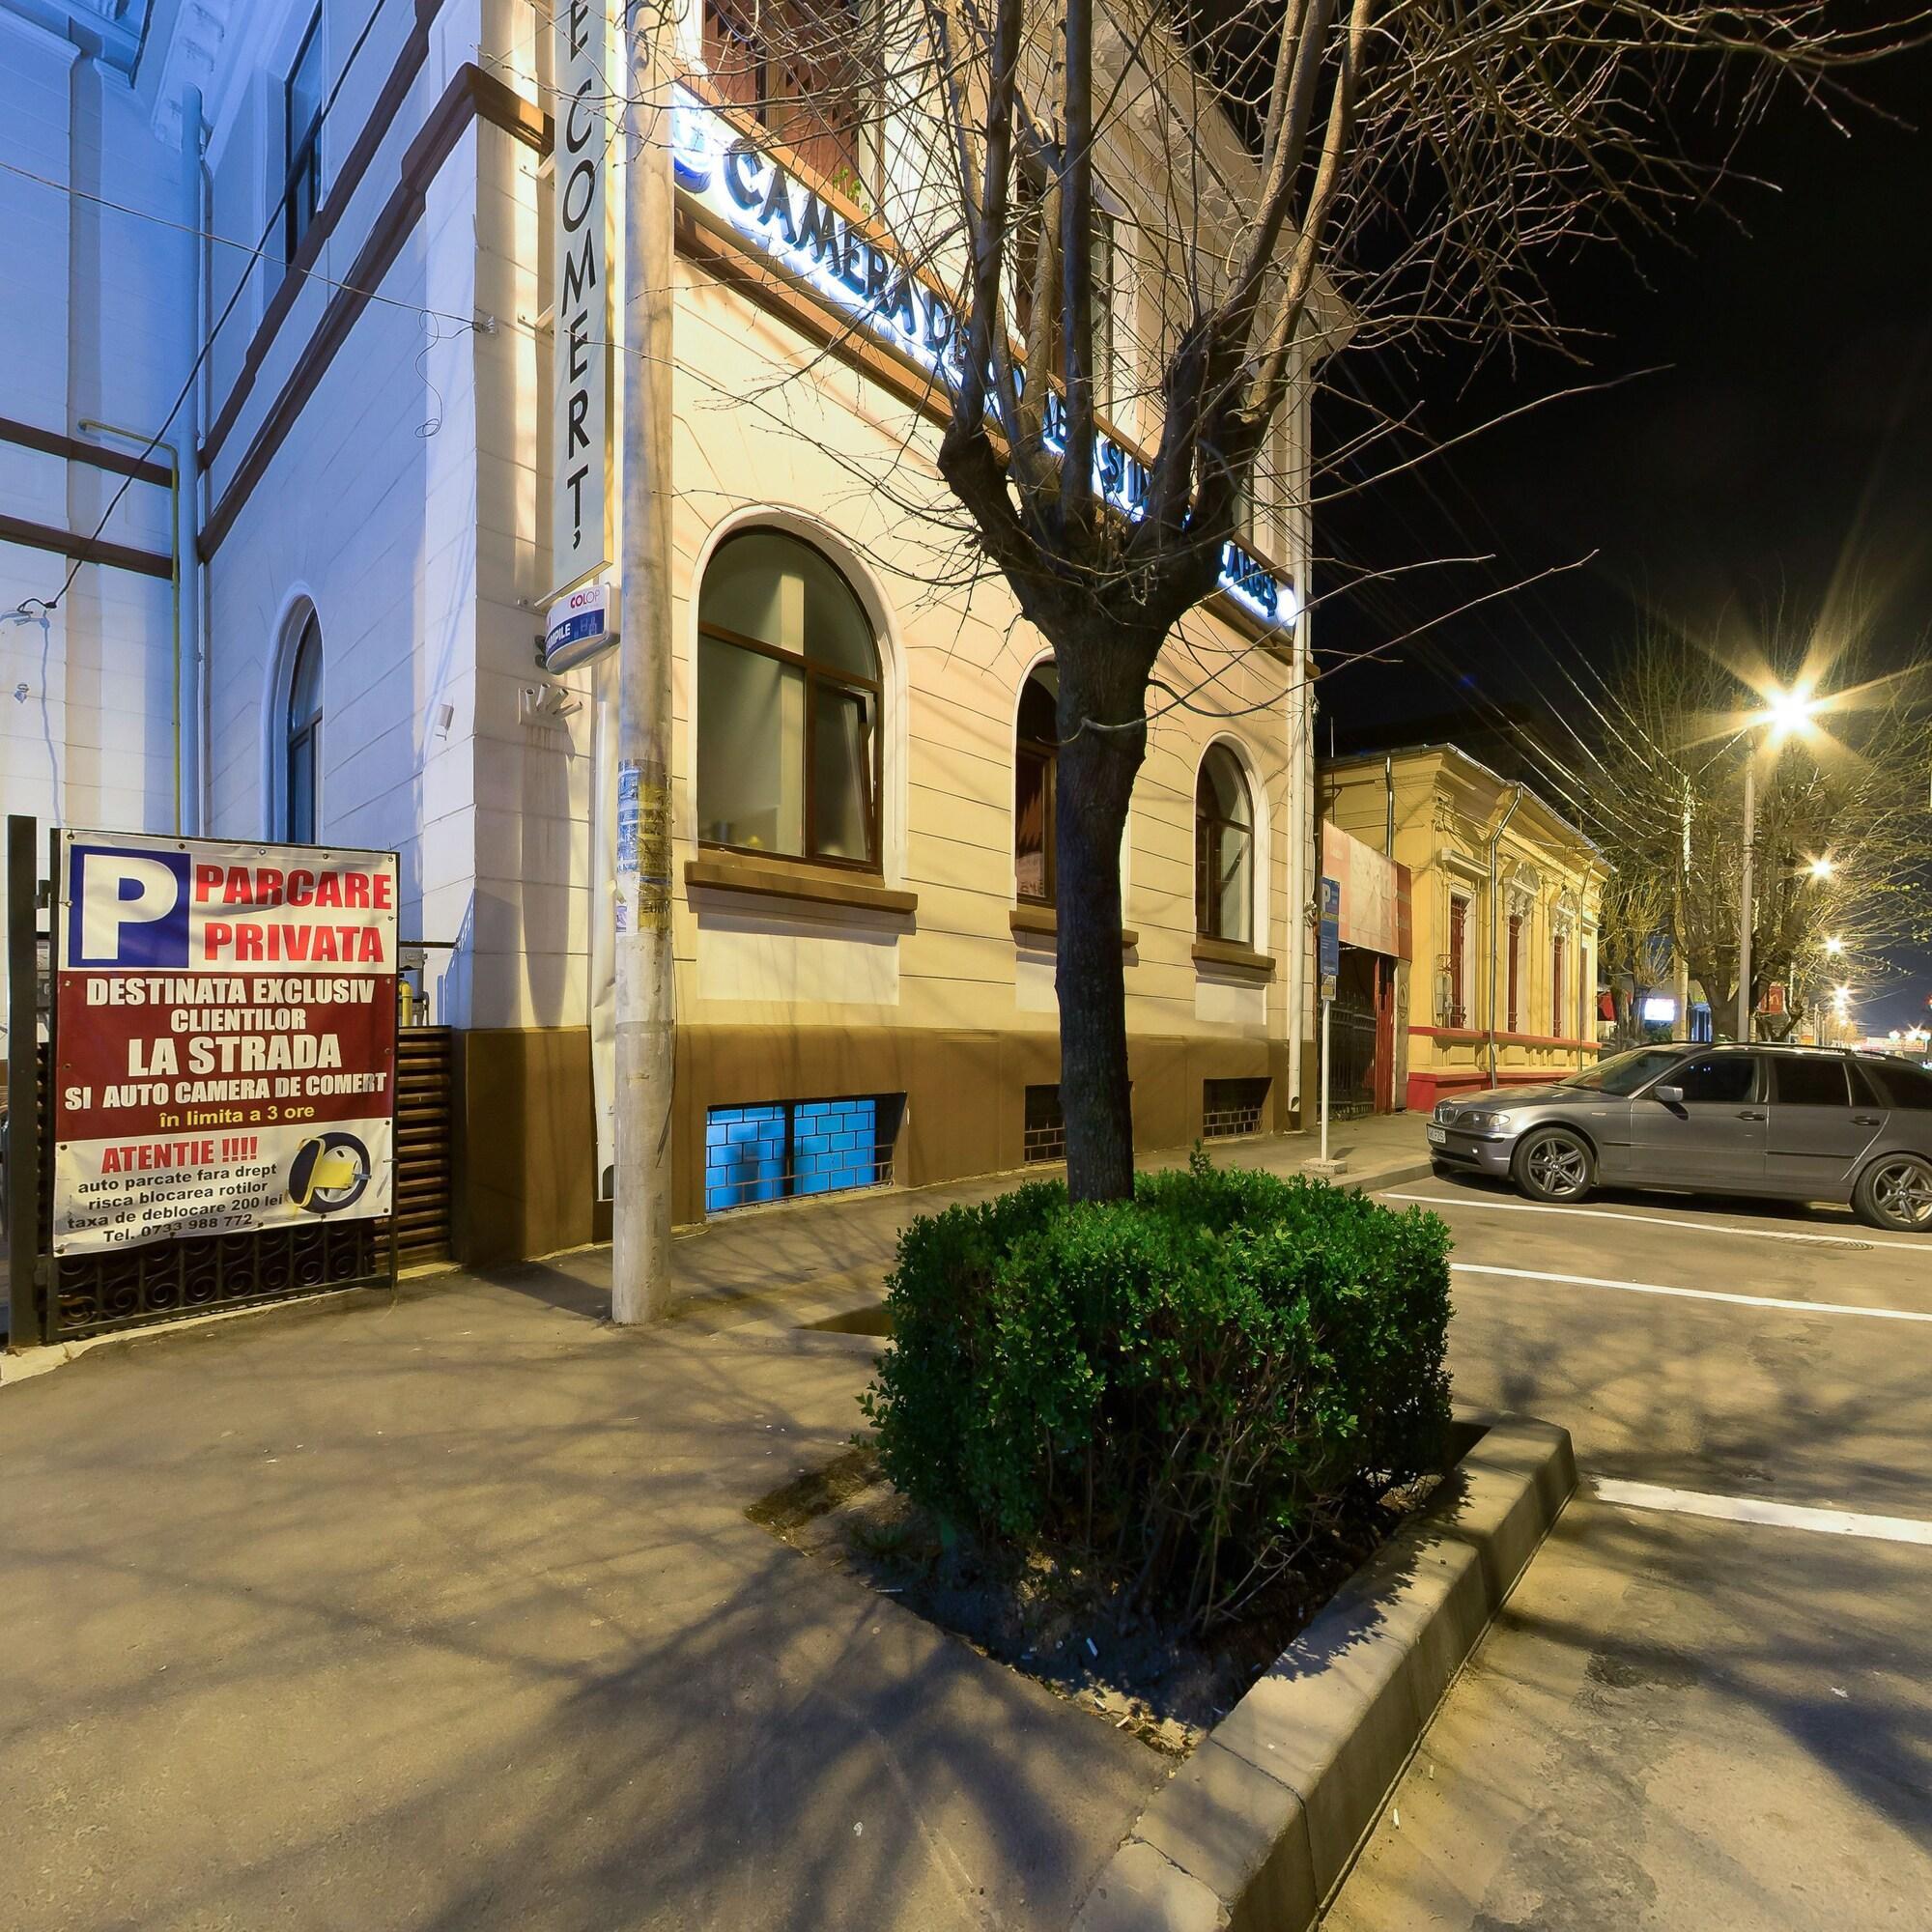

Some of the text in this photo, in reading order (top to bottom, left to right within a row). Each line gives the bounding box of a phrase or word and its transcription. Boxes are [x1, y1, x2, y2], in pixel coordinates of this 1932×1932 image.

[724, 137, 916, 335] CAMERA
[570, 589, 601, 609] COLOP
[81, 854, 391, 959] P PARCARE
[205, 923, 384, 963] PRIVATA
[86, 978, 375, 1006] DESTINATA EXCLUSIV
[170, 1009, 306, 1033] CLIENTILOR
[128, 1034, 342, 1077] LA STRADA
[65, 1072, 386, 1111] SI AUTO CAMERA DE COMERT
[159, 1106, 315, 1127] în limita a 3 ore
[101, 1136, 258, 1174] ATENTIE !!!!
[78, 1163, 277, 1193] auto parcate fara drept
[89, 1180, 268, 1210] risca blocarea rotilor
[68, 1194, 283, 1229] taxa de deblocare 200 lei
[103, 1213, 252, 1243] Tel. 0733 988 772
